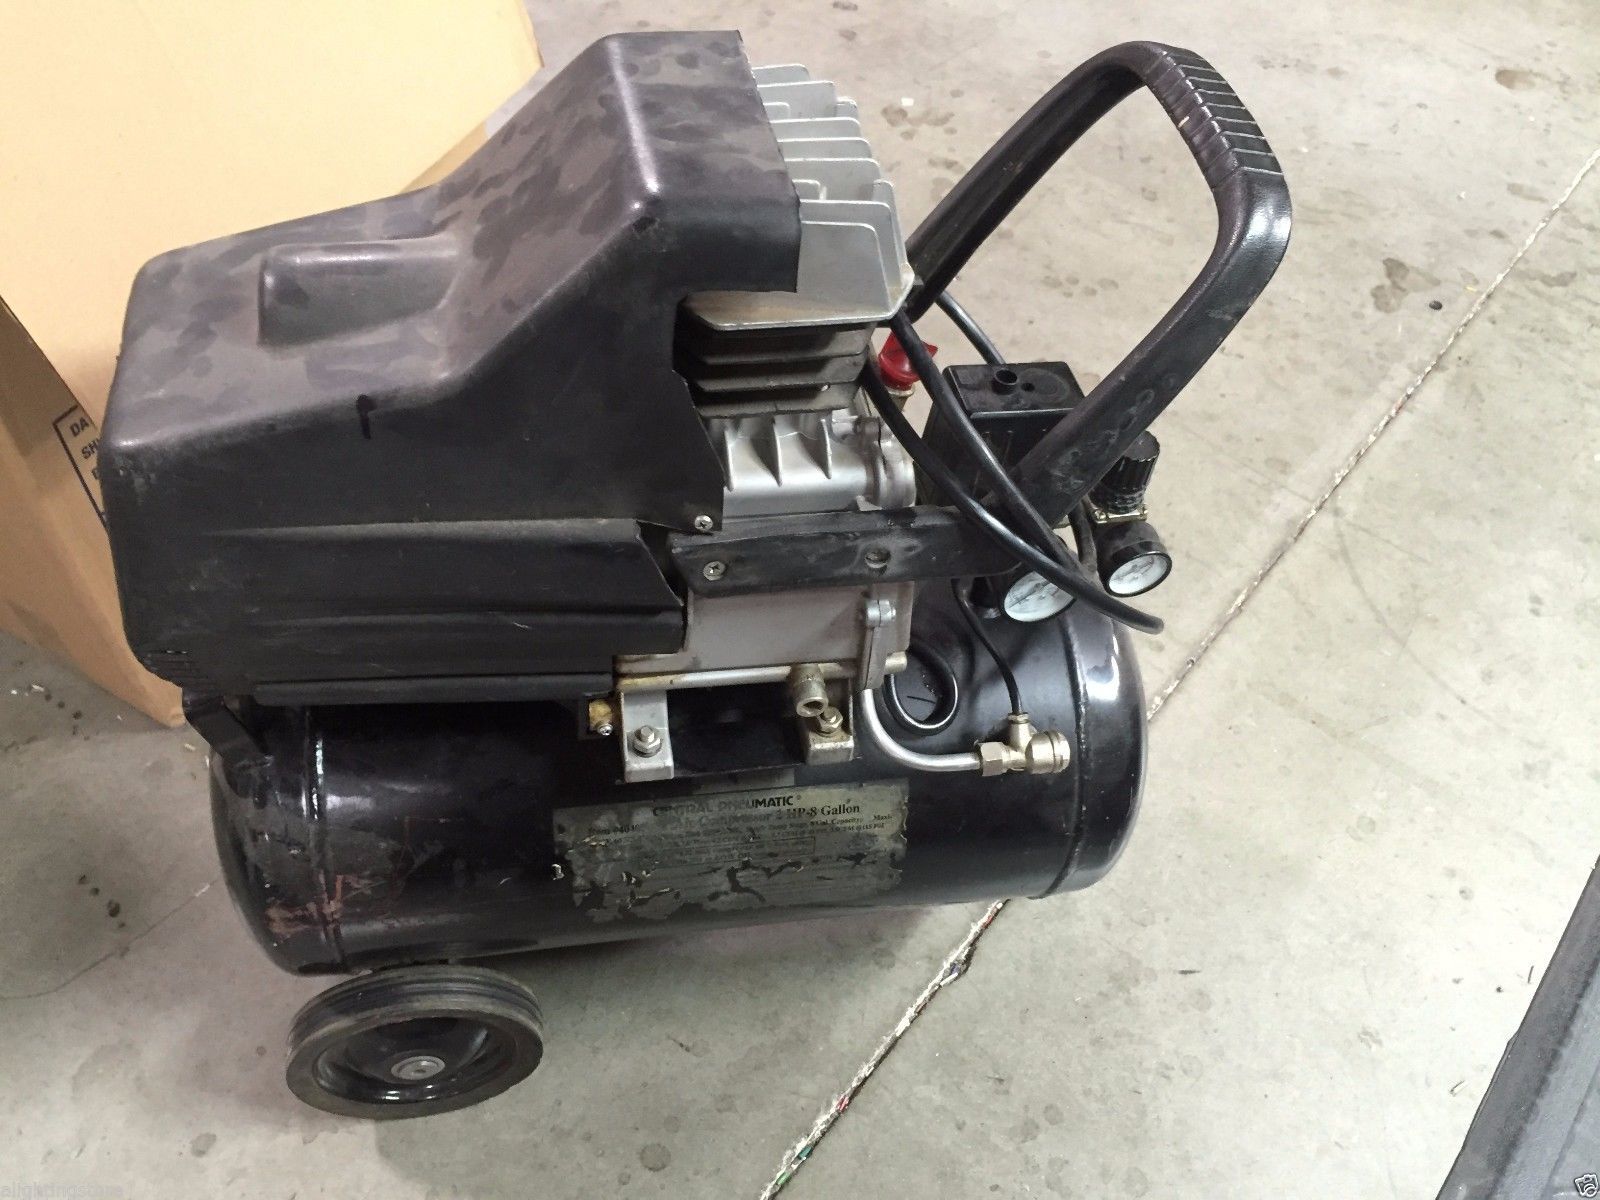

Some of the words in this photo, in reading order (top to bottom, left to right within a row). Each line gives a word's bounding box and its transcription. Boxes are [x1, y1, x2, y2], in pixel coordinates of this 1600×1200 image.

[70, 417, 90, 437] DA
[81, 438, 100, 460] SH
[820, 804, 861, 817] Gallon
